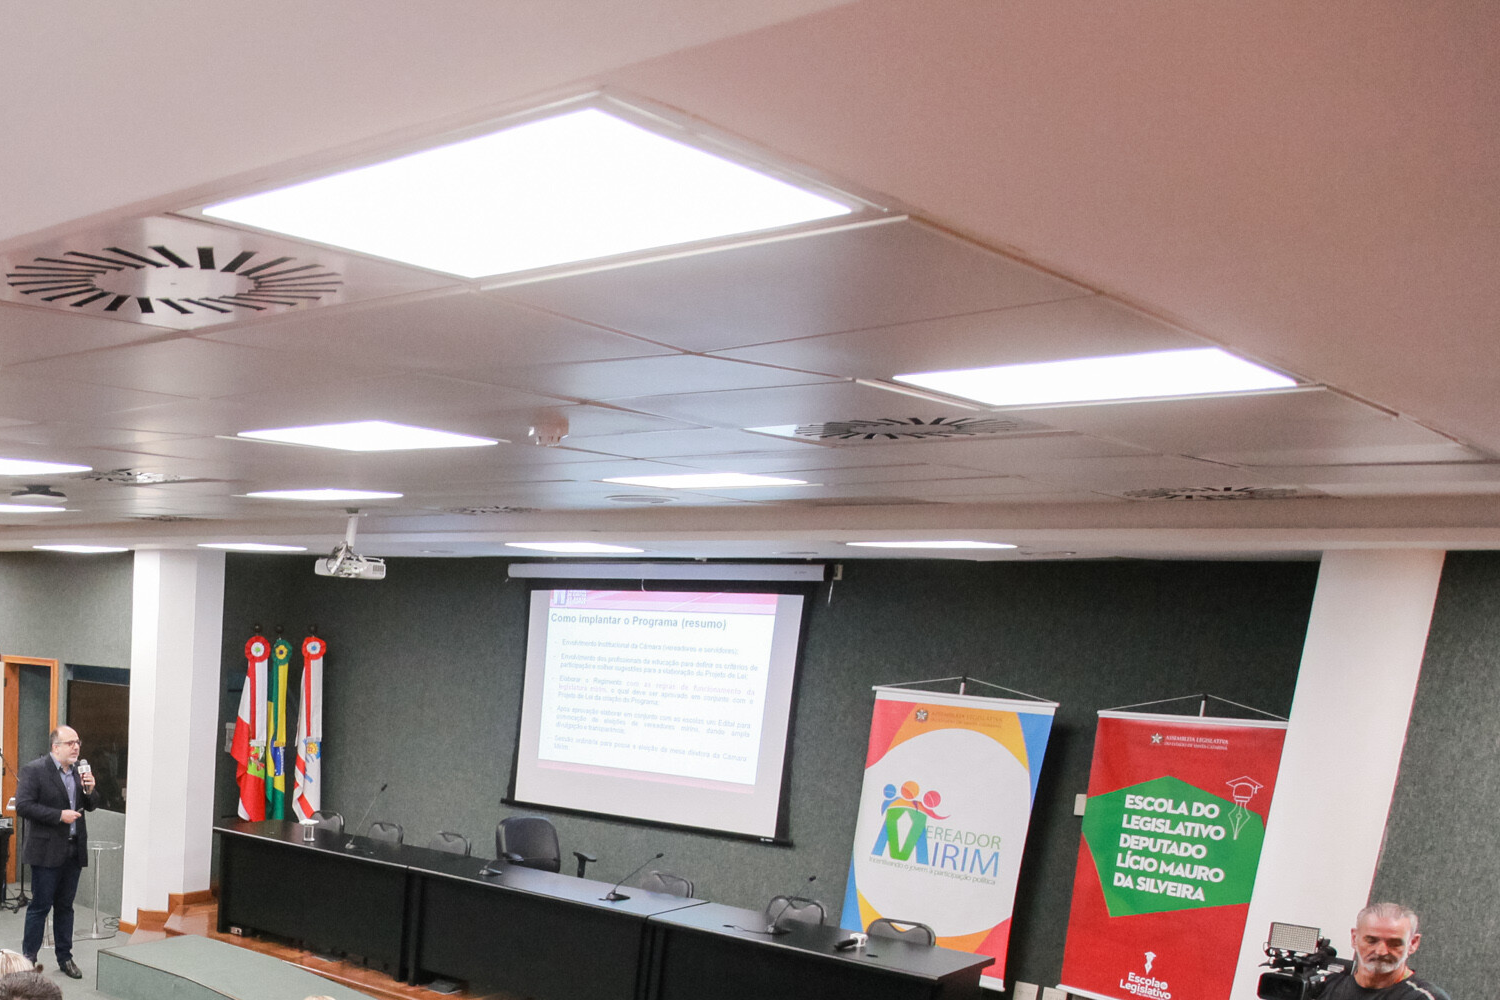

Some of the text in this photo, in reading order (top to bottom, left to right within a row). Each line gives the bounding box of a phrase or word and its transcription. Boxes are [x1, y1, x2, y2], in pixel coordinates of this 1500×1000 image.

[551, 613, 577, 623] Como
[579, 614, 621, 625] implantar
[632, 616, 678, 628] Programa
[681, 618, 727, 631] (resumo)
[1124, 794, 1220, 819] ESCOLA DO
[1121, 814, 1226, 841] LEGISLATIVO
[1119, 833, 1208, 859] DEPUTADO
[908, 864, 928, 873] jovem
[934, 868, 972, 881] participação
[1116, 850, 1225, 883] LÍCIO MAURO
[1113, 872, 1205, 902] DA SILVEIRA
[1119, 978, 1172, 1000] Legislativo
[1128, 972, 1160, 988] Escola
